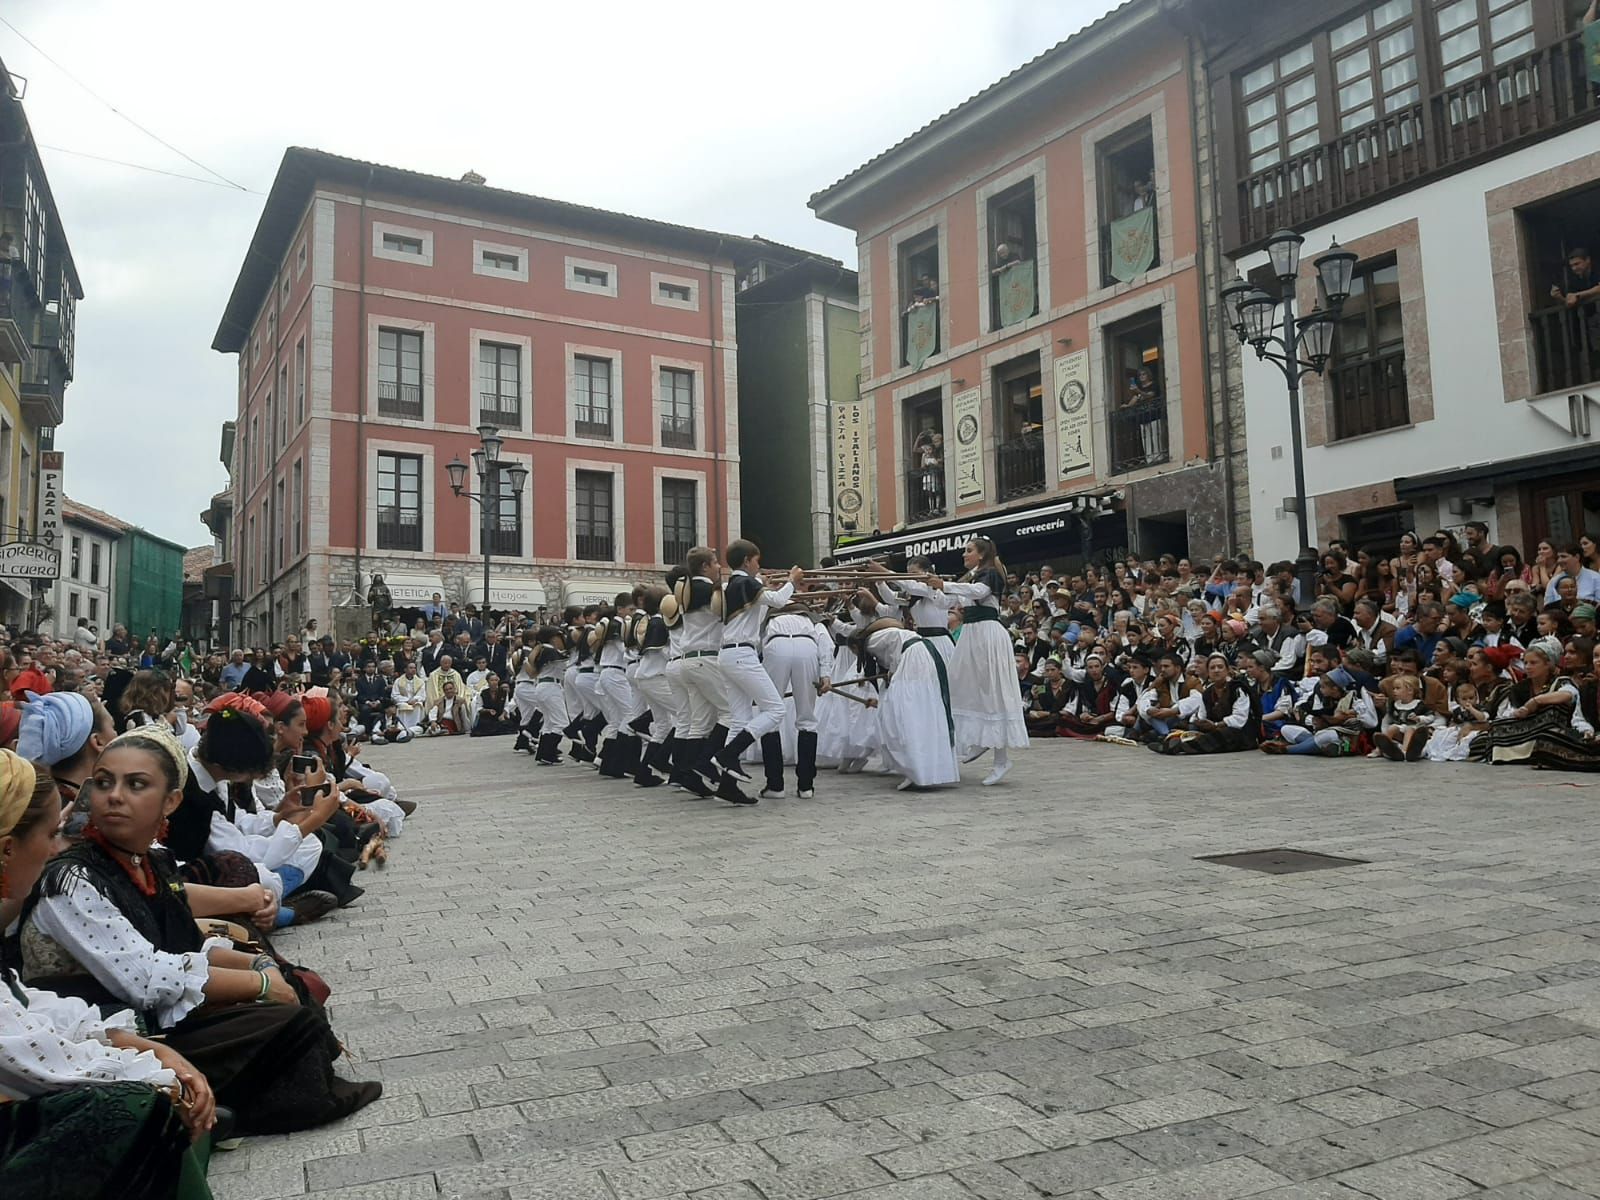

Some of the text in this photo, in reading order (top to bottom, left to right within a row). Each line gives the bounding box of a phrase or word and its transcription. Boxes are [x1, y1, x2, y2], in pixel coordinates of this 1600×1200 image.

[837, 406, 846, 487] PASTA PIZZA
[852, 405, 860, 489] LOS ITALIANOS
[44, 473, 57, 516] PLAZA
[1371, 490, 1378, 503] 6
[42, 520, 57, 546] MAY
[1016, 517, 1065, 536] cervecería
[391, 588, 430, 598] IETETICA
